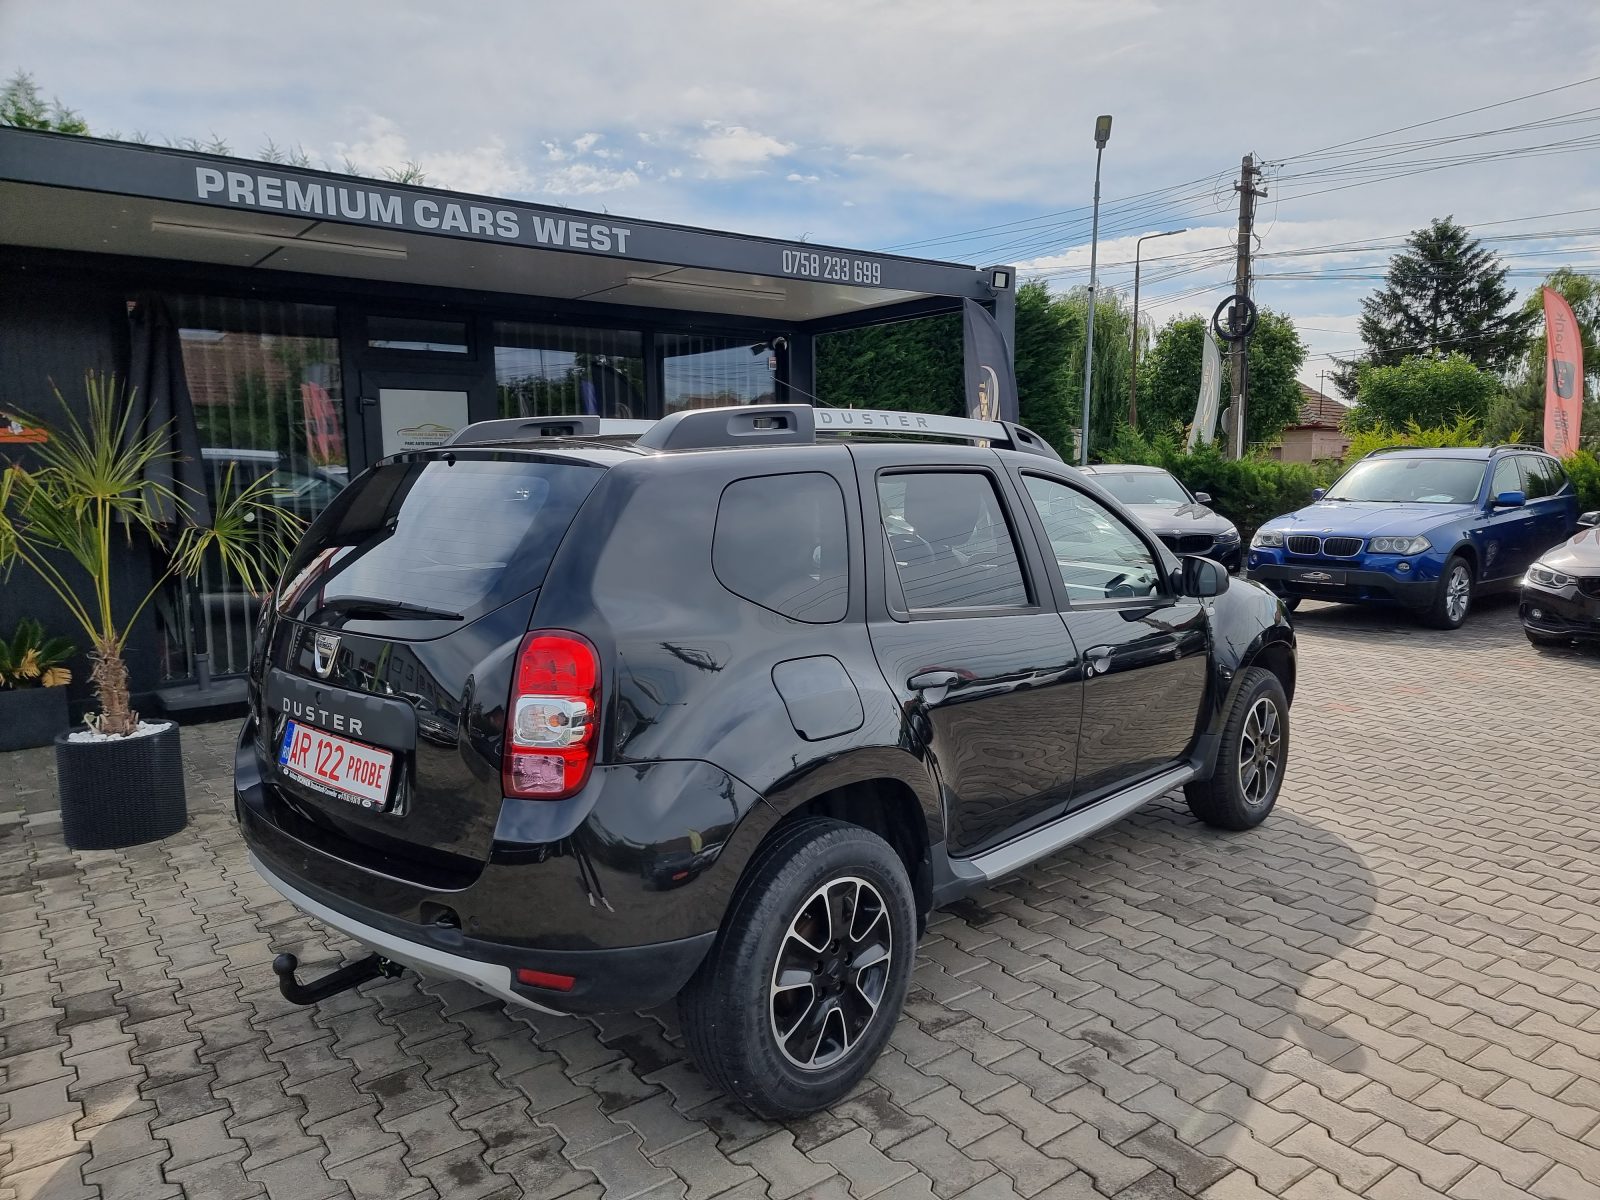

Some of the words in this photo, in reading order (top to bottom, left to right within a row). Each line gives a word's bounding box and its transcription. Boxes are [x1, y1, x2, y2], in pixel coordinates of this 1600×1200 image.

[195, 167, 403, 225] PREMIUM
[413, 200, 520, 238] CARS
[532, 216, 631, 253] WEST
[782, 249, 820, 277] 0758
[823, 255, 850, 281] 233
[854, 260, 881, 285] 699
[819, 412, 929, 428] DUSTER
[283, 697, 363, 736] DUSTER
[290, 730, 312, 769] AR
[314, 738, 345, 782] 122
[345, 755, 385, 789] PROBE
